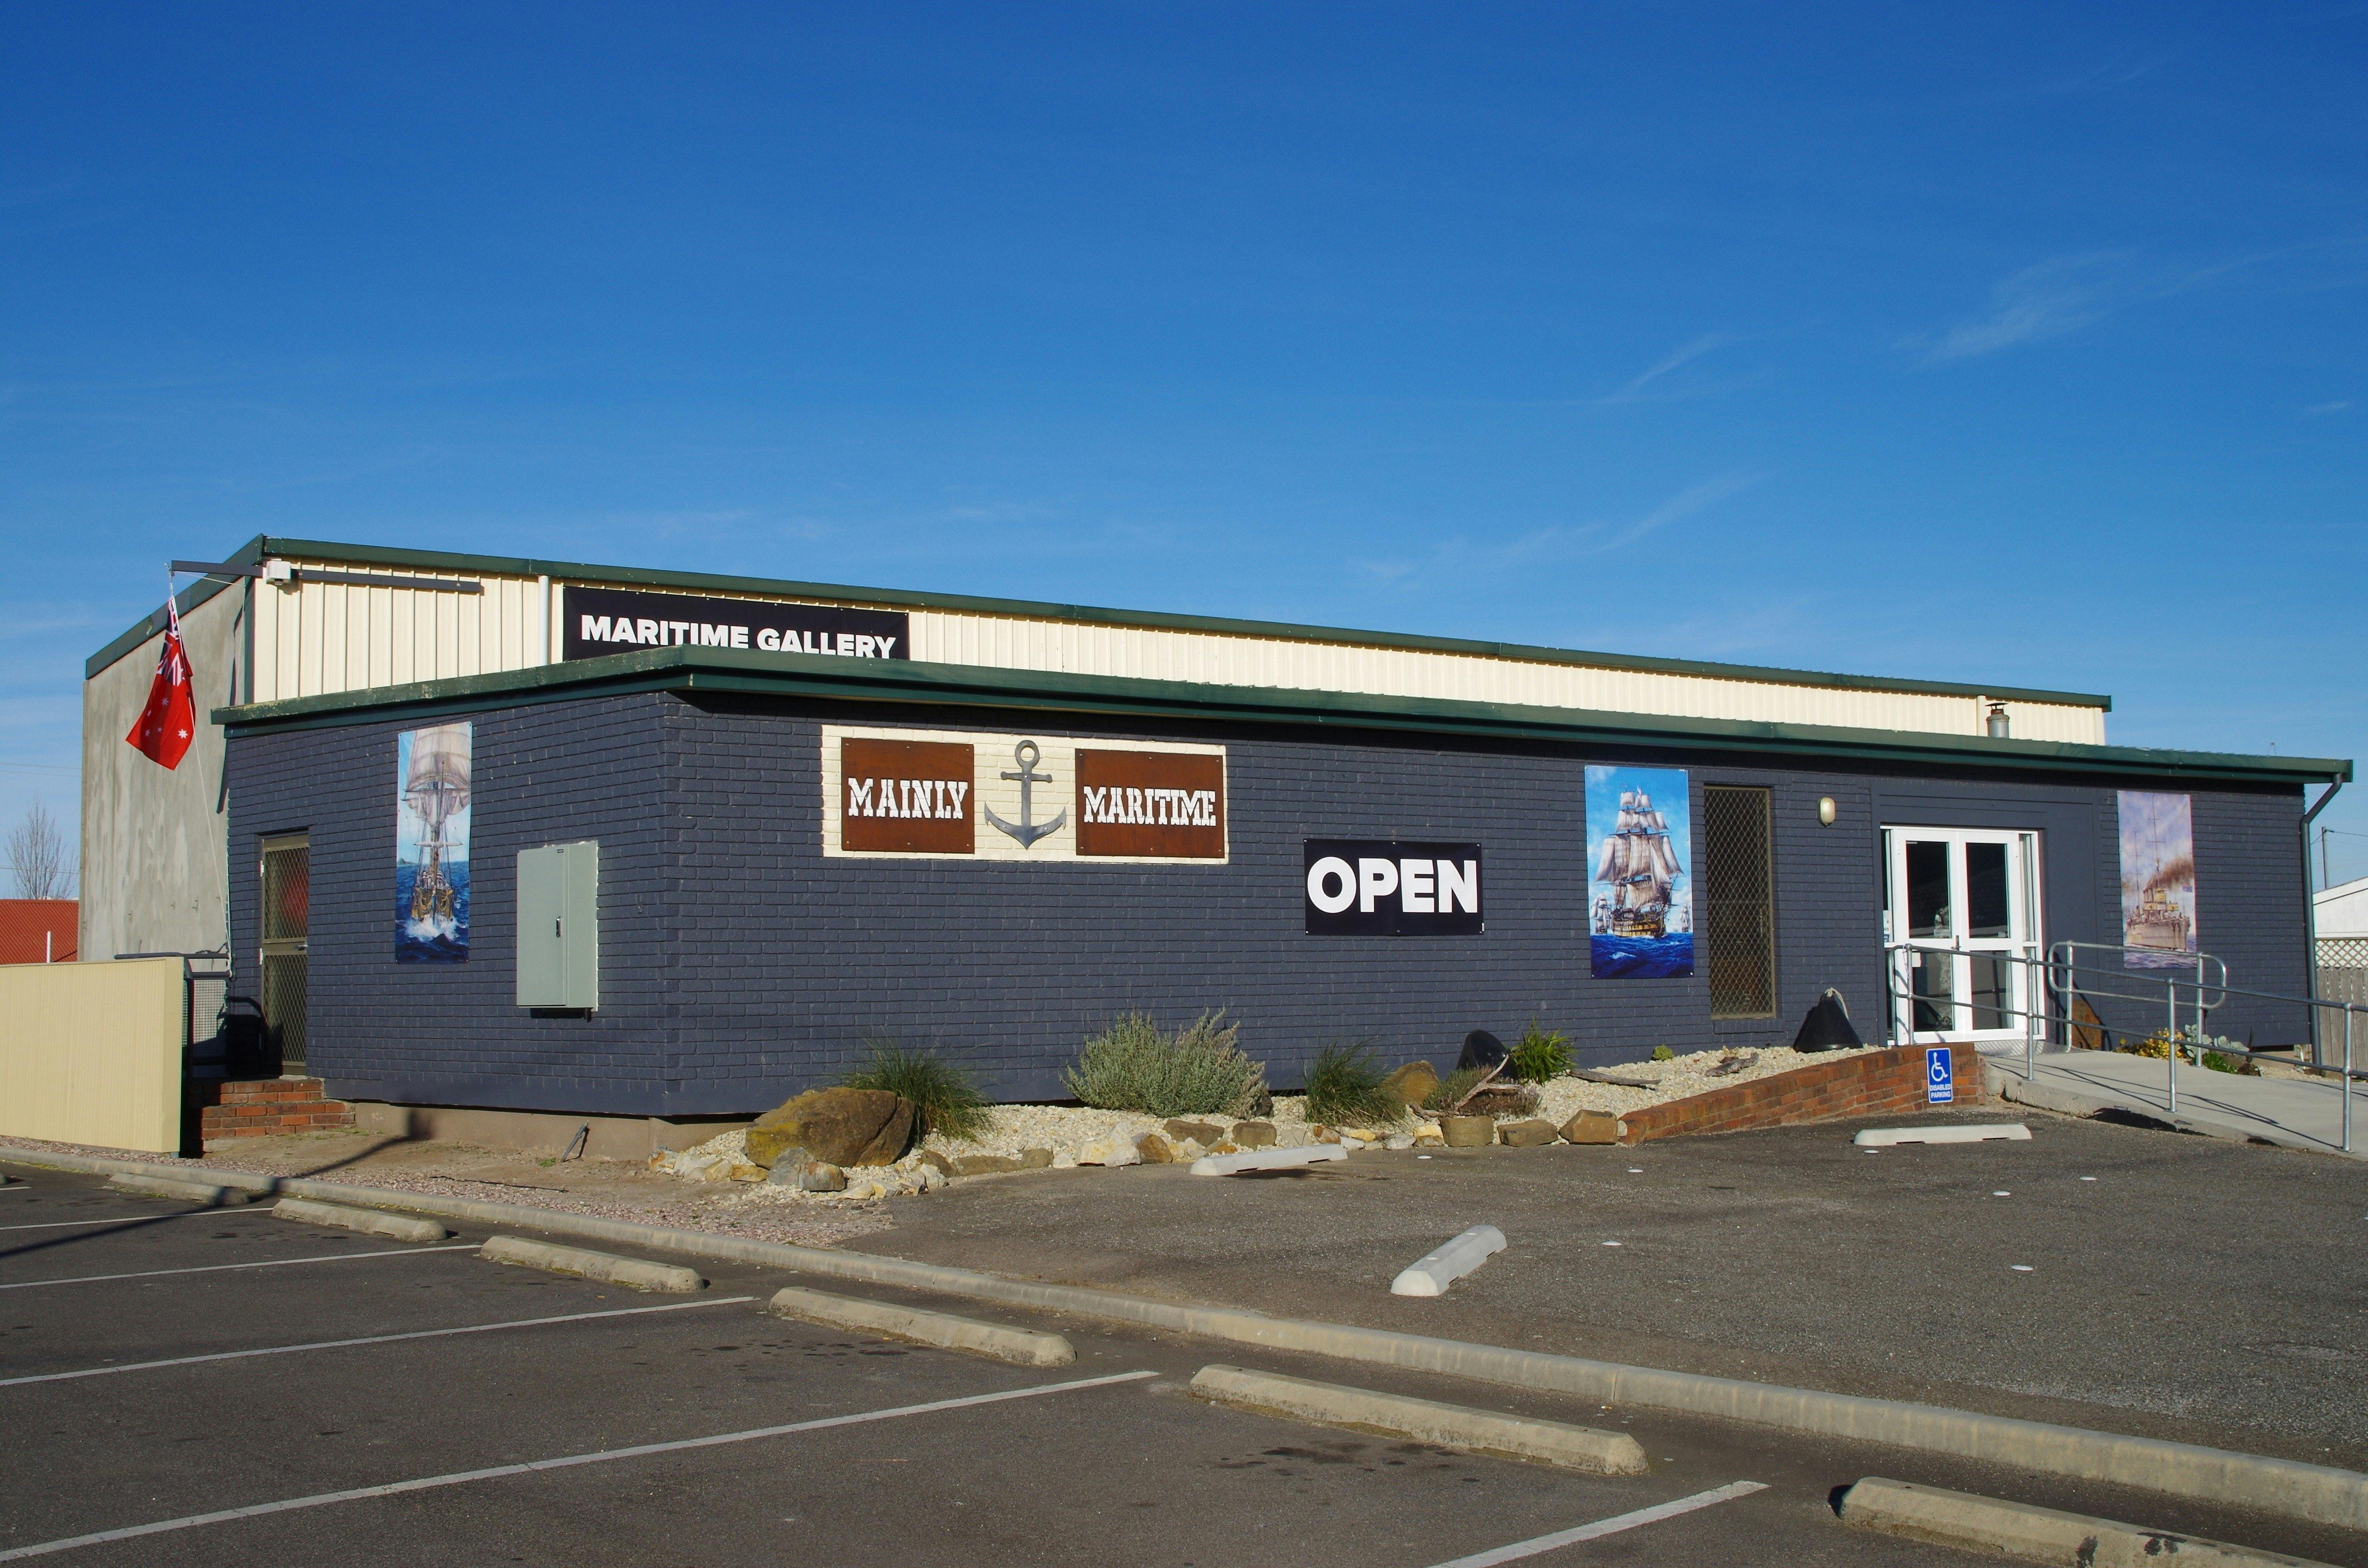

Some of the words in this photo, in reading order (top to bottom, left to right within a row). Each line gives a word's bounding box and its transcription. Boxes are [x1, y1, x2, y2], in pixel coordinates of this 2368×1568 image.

[581, 614, 749, 649] MARITIME
[756, 628, 897, 659] GALLERY
[848, 777, 969, 820] MAINLY
[1083, 785, 1217, 827] MARITIME
[1307, 856, 1478, 914] OPEN
